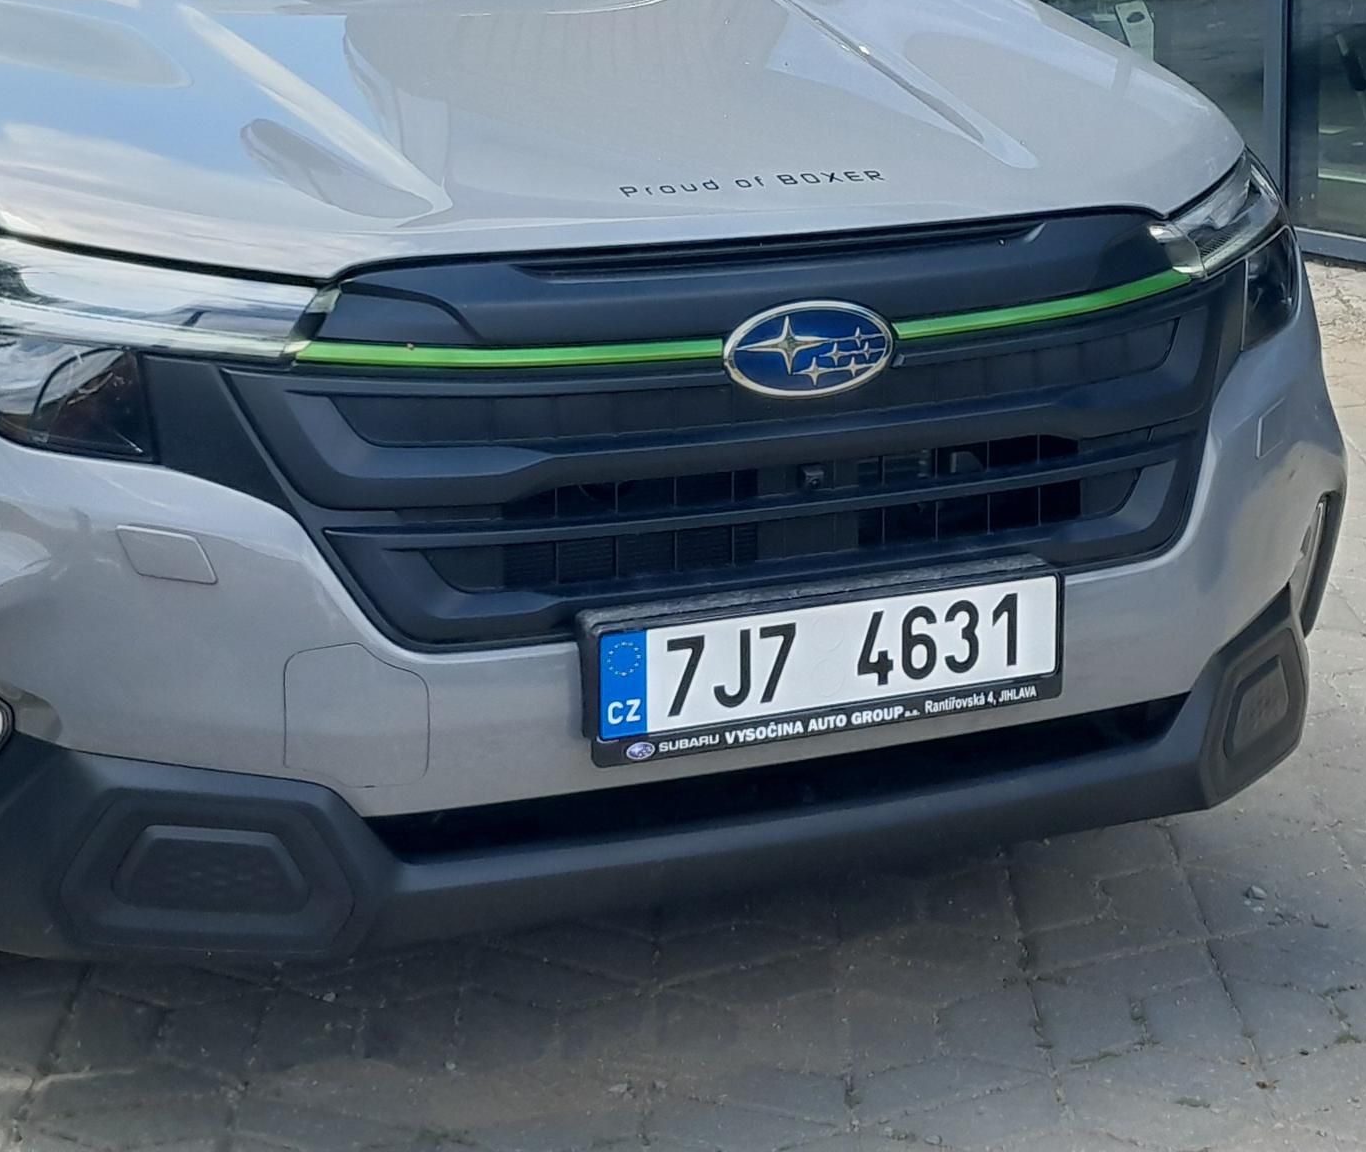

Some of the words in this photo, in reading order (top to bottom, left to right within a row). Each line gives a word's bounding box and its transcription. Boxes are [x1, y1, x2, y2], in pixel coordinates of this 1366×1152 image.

[619, 178, 720, 197] Proud
[735, 176, 765, 189] of
[776, 170, 886, 185] BOXER
[666, 622, 797, 717] 7J7
[857, 593, 1019, 686] 4631
[607, 699, 641, 725] CZ
[658, 733, 720, 752] SUBARU
[724, 720, 804, 744] VYSOČINA
[808, 714, 848, 732] AUTO
[851, 706, 904, 725] GROUP
[925, 693, 985, 714] Rantířovská
[987, 690, 997, 706] 4,
[998, 685, 1037, 703] JIHLAVA
